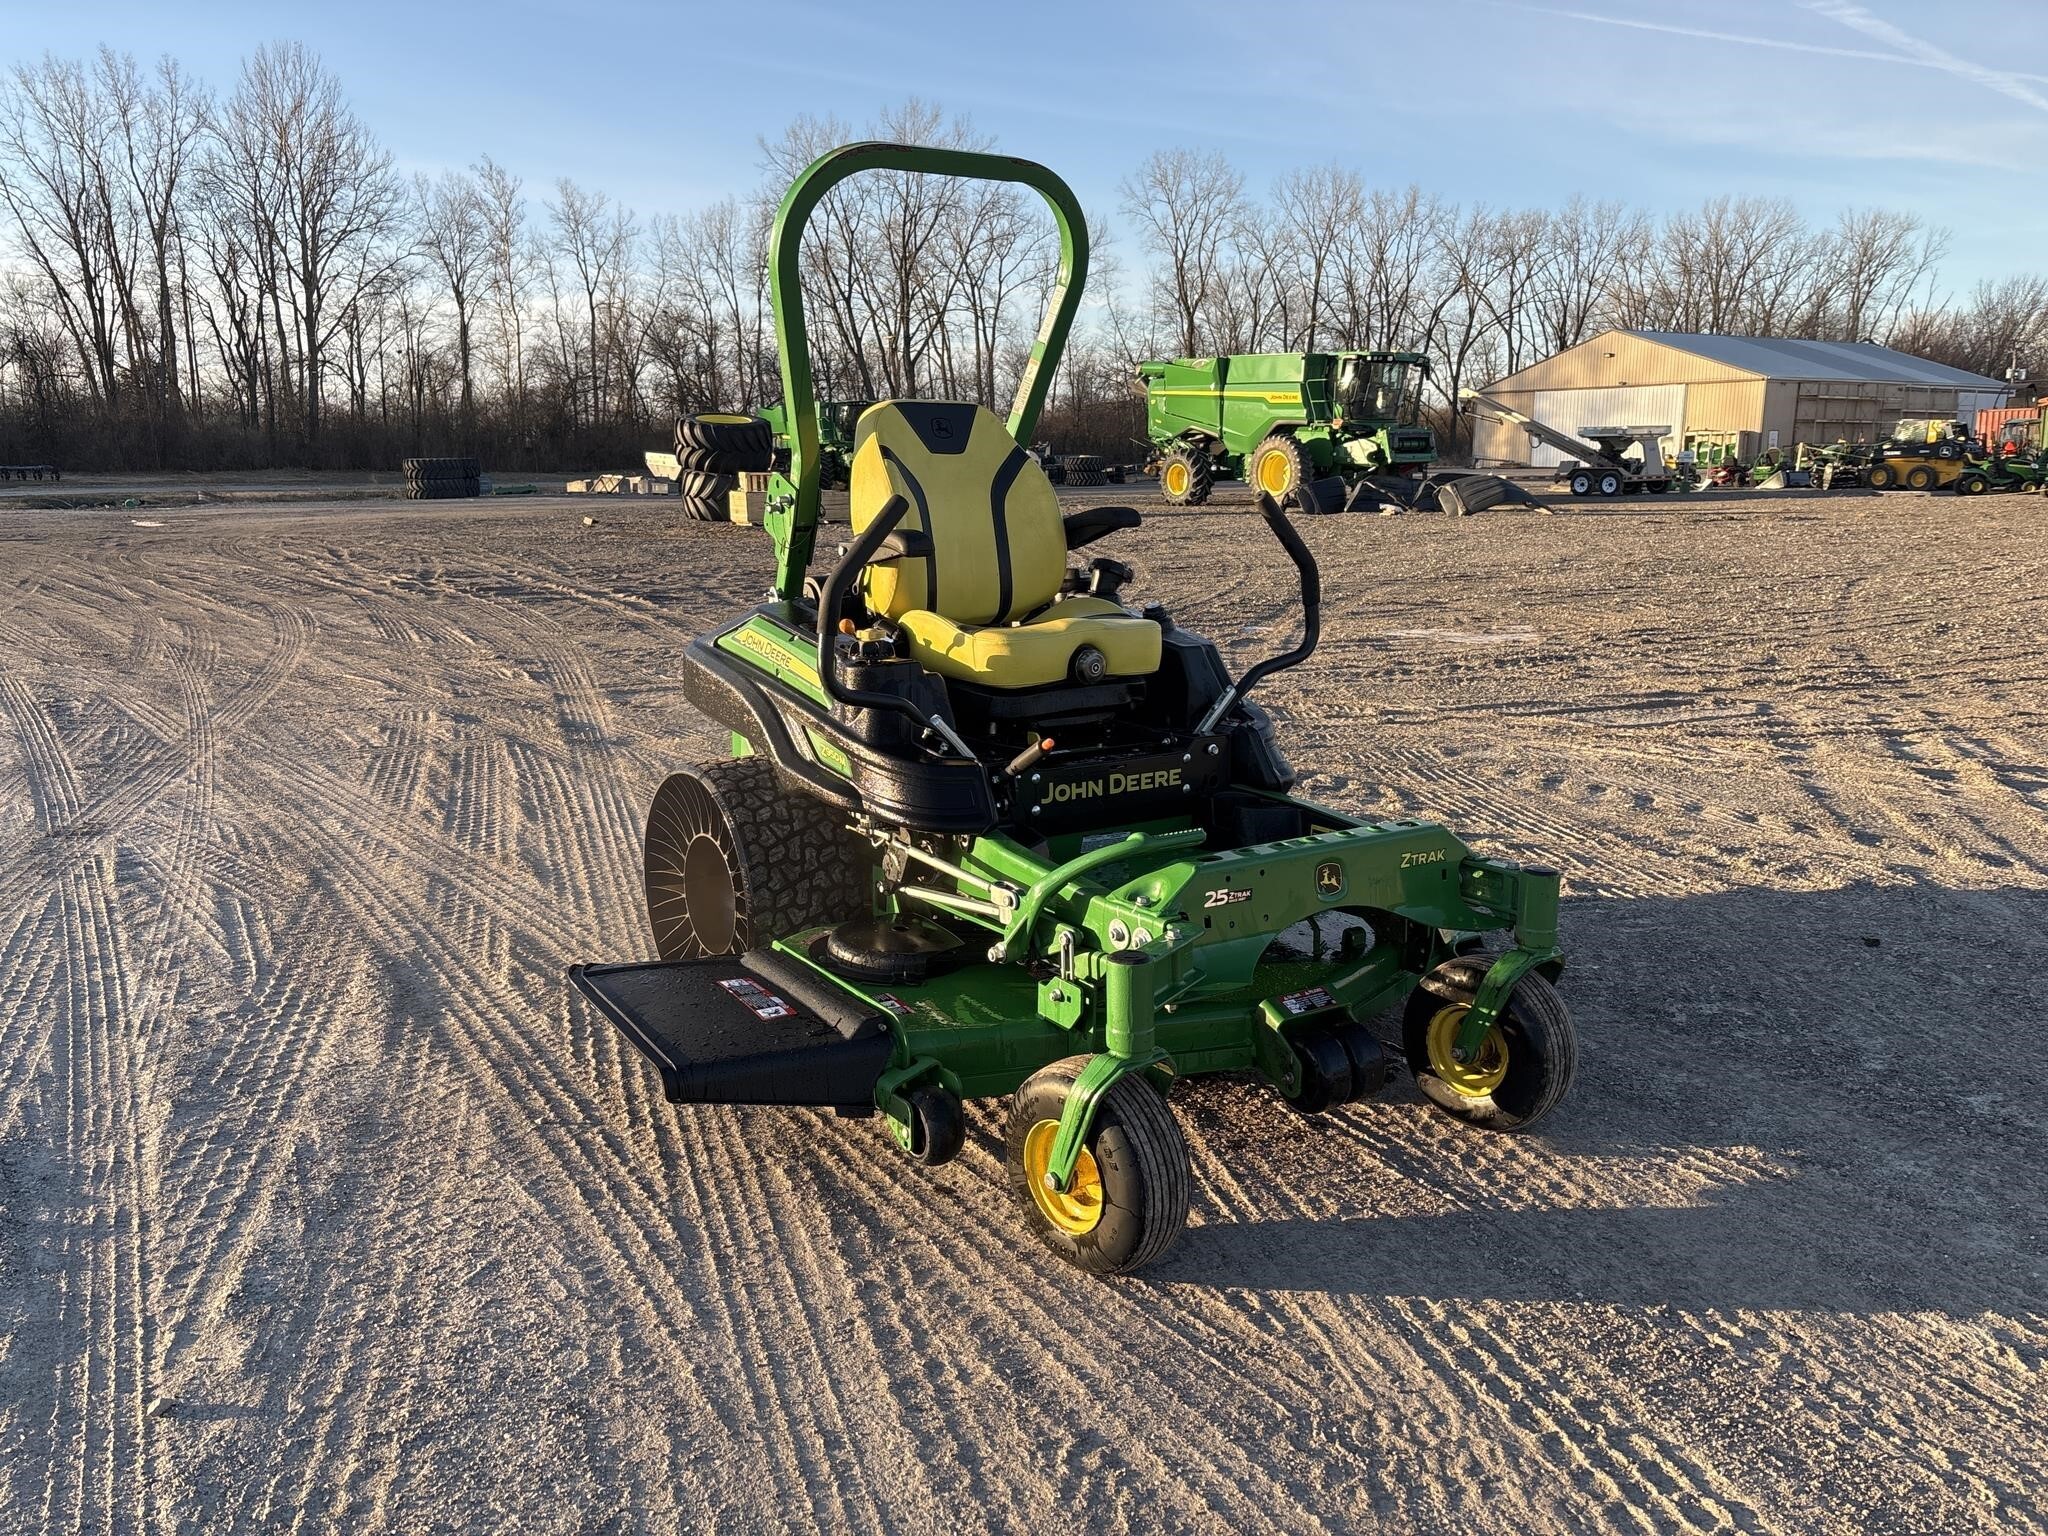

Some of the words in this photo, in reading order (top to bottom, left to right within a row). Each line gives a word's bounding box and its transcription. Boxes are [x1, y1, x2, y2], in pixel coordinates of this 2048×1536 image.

[741, 632, 764, 651] JOHN
[765, 643, 792, 667] DEERE
[1041, 779, 1103, 804] JOHN
[1109, 768, 1182, 795] DEERE
[1400, 849, 1446, 869] ZTRAK
[1204, 888, 1229, 908] 25
[1228, 890, 1252, 900] ZTRAK
